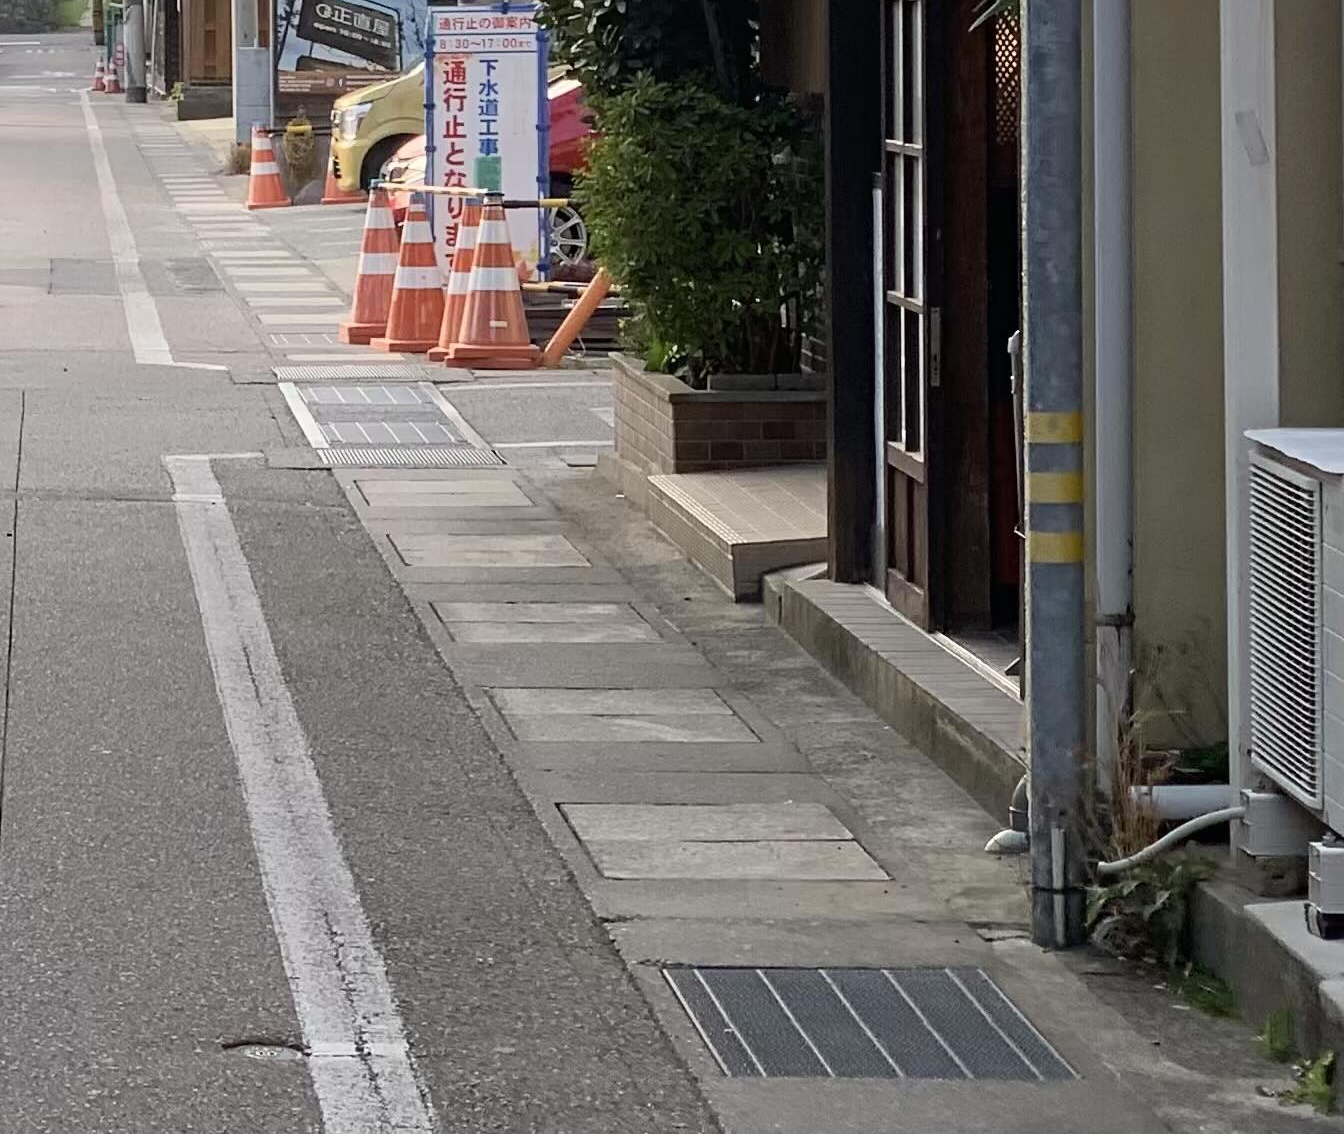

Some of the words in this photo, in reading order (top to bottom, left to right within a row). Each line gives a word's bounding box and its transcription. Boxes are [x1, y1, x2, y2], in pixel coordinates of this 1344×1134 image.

[439, 17, 533, 31] 通行止の御案内
[478, 58, 500, 156] 下水道工事
